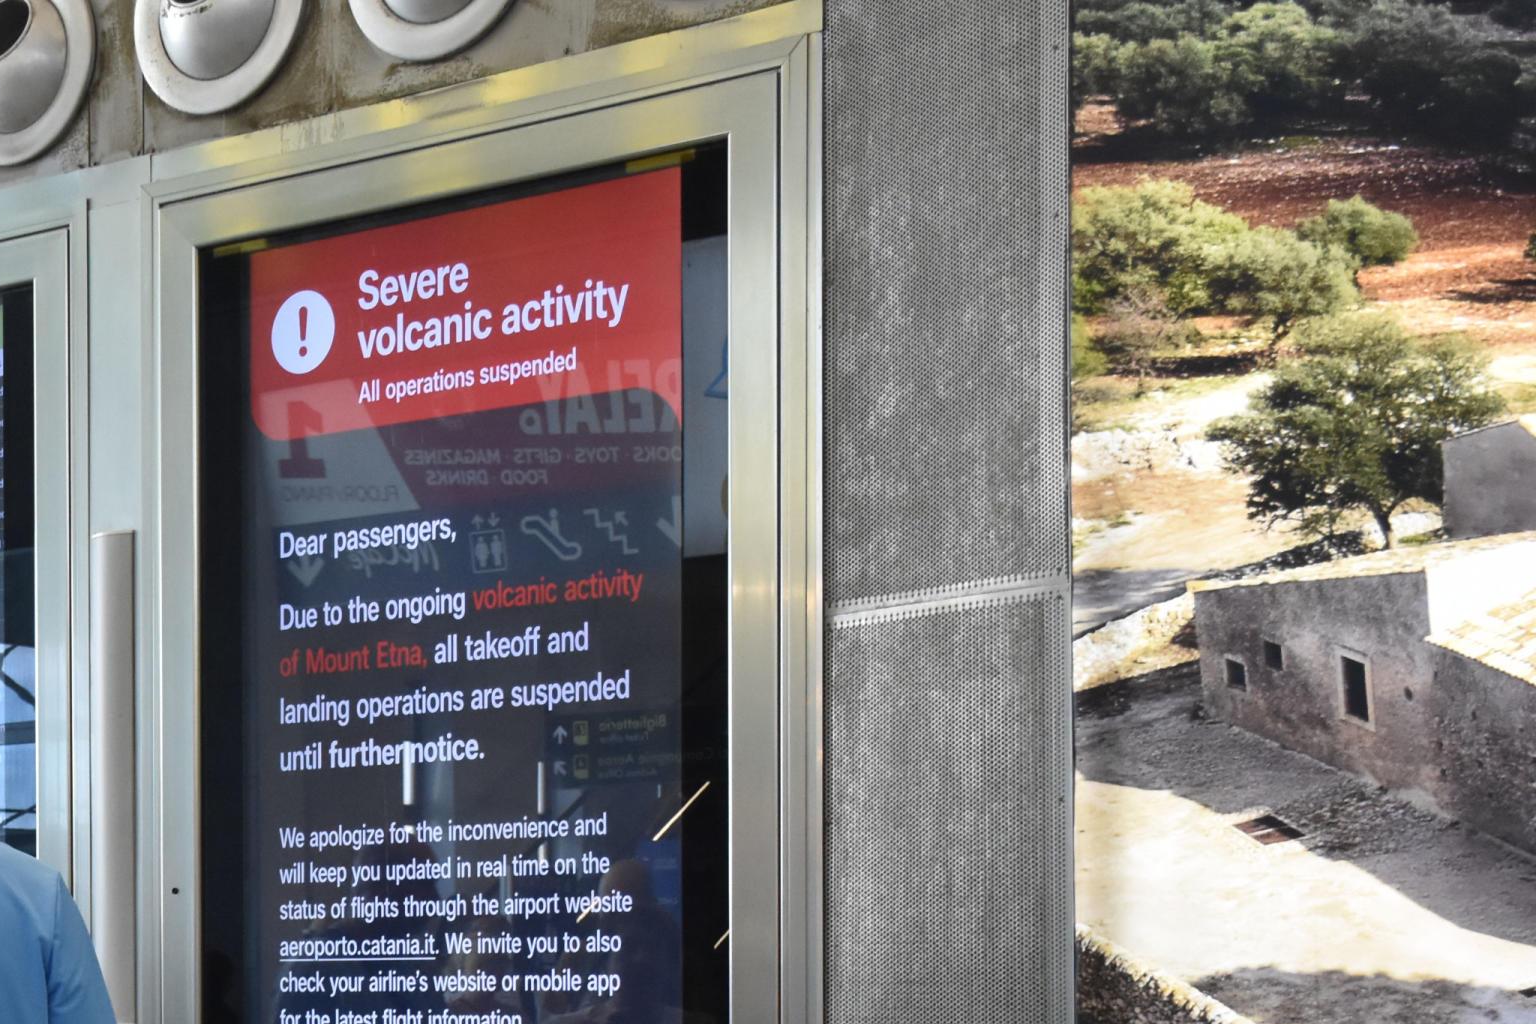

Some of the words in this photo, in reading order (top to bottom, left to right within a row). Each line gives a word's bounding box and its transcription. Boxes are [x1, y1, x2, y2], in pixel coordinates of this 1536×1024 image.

[357, 262, 469, 311] Severe
[358, 301, 492, 359] volcanic
[502, 279, 629, 336] activity
[358, 379, 380, 404] All
[386, 367, 475, 403] operations
[480, 348, 577, 389] suspended
[280, 531, 326, 559] Dear
[334, 517, 457, 559] passengers,
[280, 603, 318, 630] Due
[323, 600, 342, 626] to
[348, 596, 380, 624] the
[385, 588, 466, 625] ongoing
[474, 577, 557, 611] volcanic
[565, 569, 643, 603] activity
[280, 649, 301, 677] of
[306, 640, 369, 674] Mount
[377, 640, 428, 670] Etna,
[434, 634, 458, 664] all
[464, 626, 540, 660] takeoff
[548, 622, 589, 654] and
[280, 696, 349, 731] landing
[356, 686, 464, 728] operations
[471, 686, 504, 709] are
[511, 670, 630, 711] suspended
[280, 743, 322, 772] until
[329, 740, 405, 767] further
[410, 734, 485, 764] notice.
[280, 827, 305, 849] We
[310, 823, 384, 852] apologize
[390, 821, 412, 844] for
[416, 820, 443, 843] the
[448, 816, 569, 842] inconvenience
[574, 812, 607, 836] and
[280, 861, 305, 884] will
[310, 859, 346, 888] keep
[352, 863, 381, 887] you
[386, 856, 451, 887] updated
[457, 856, 471, 879] in
[476, 855, 506, 878] real
[512, 854, 548, 877] time
[554, 856, 576, 876] on
[582, 852, 610, 875] the
[280, 898, 325, 920] status
[331, 897, 347, 919] of
[351, 895, 398, 923] flights
[404, 894, 467, 921] through
[472, 893, 499, 916] the
[504, 891, 560, 919] airport
[565, 889, 632, 914] website
[280, 933, 440, 961] aeroporto.catania.it.
[445, 934, 472, 955] We
[477, 932, 522, 955] invite
[527, 936, 558, 958] you
[563, 932, 581, 954] to
[586, 930, 621, 953] also
[280, 971, 325, 993] check
[329, 974, 364, 997] your
[433, 970, 496, 992] website
[502, 974, 519, 992] or
[524, 969, 582, 992] mobile
[587, 973, 620, 996] app
